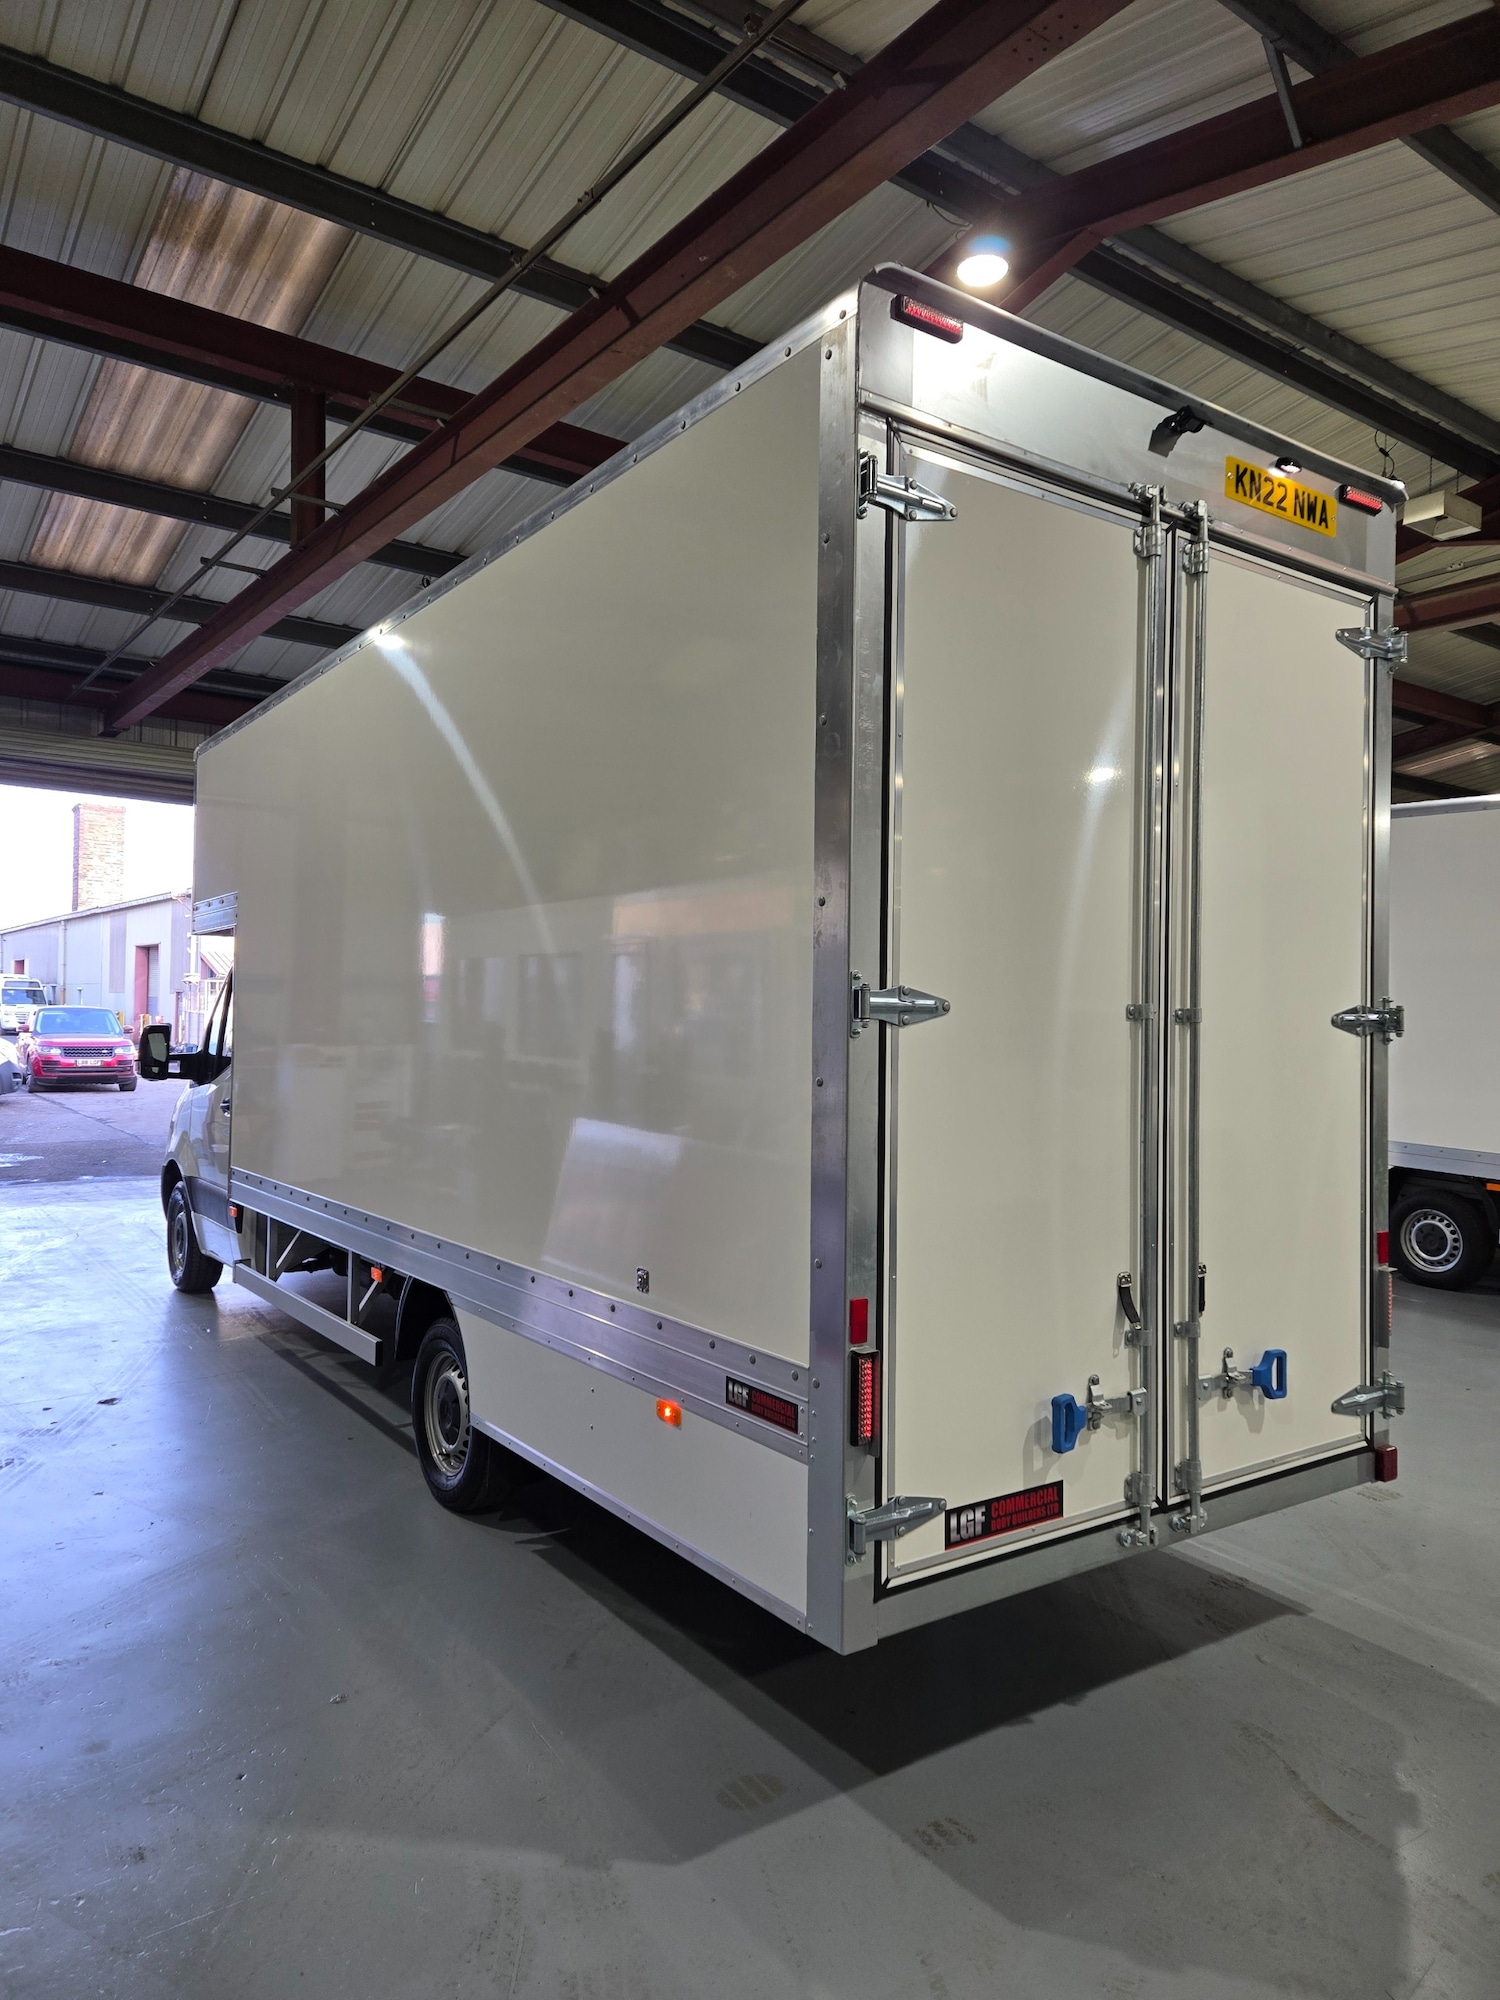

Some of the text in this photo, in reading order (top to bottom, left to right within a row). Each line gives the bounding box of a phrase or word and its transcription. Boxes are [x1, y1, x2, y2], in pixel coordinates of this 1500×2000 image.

[1235, 464, 1329, 529] KN22 NWA
[728, 1380, 749, 1408] LGF
[752, 1390, 795, 1417] COMMERCIAL
[991, 1486, 1059, 1518] COMMERCIAL
[991, 1502, 1059, 1531] BODY BUILDERS LTD
[950, 1505, 986, 1542] LGF
